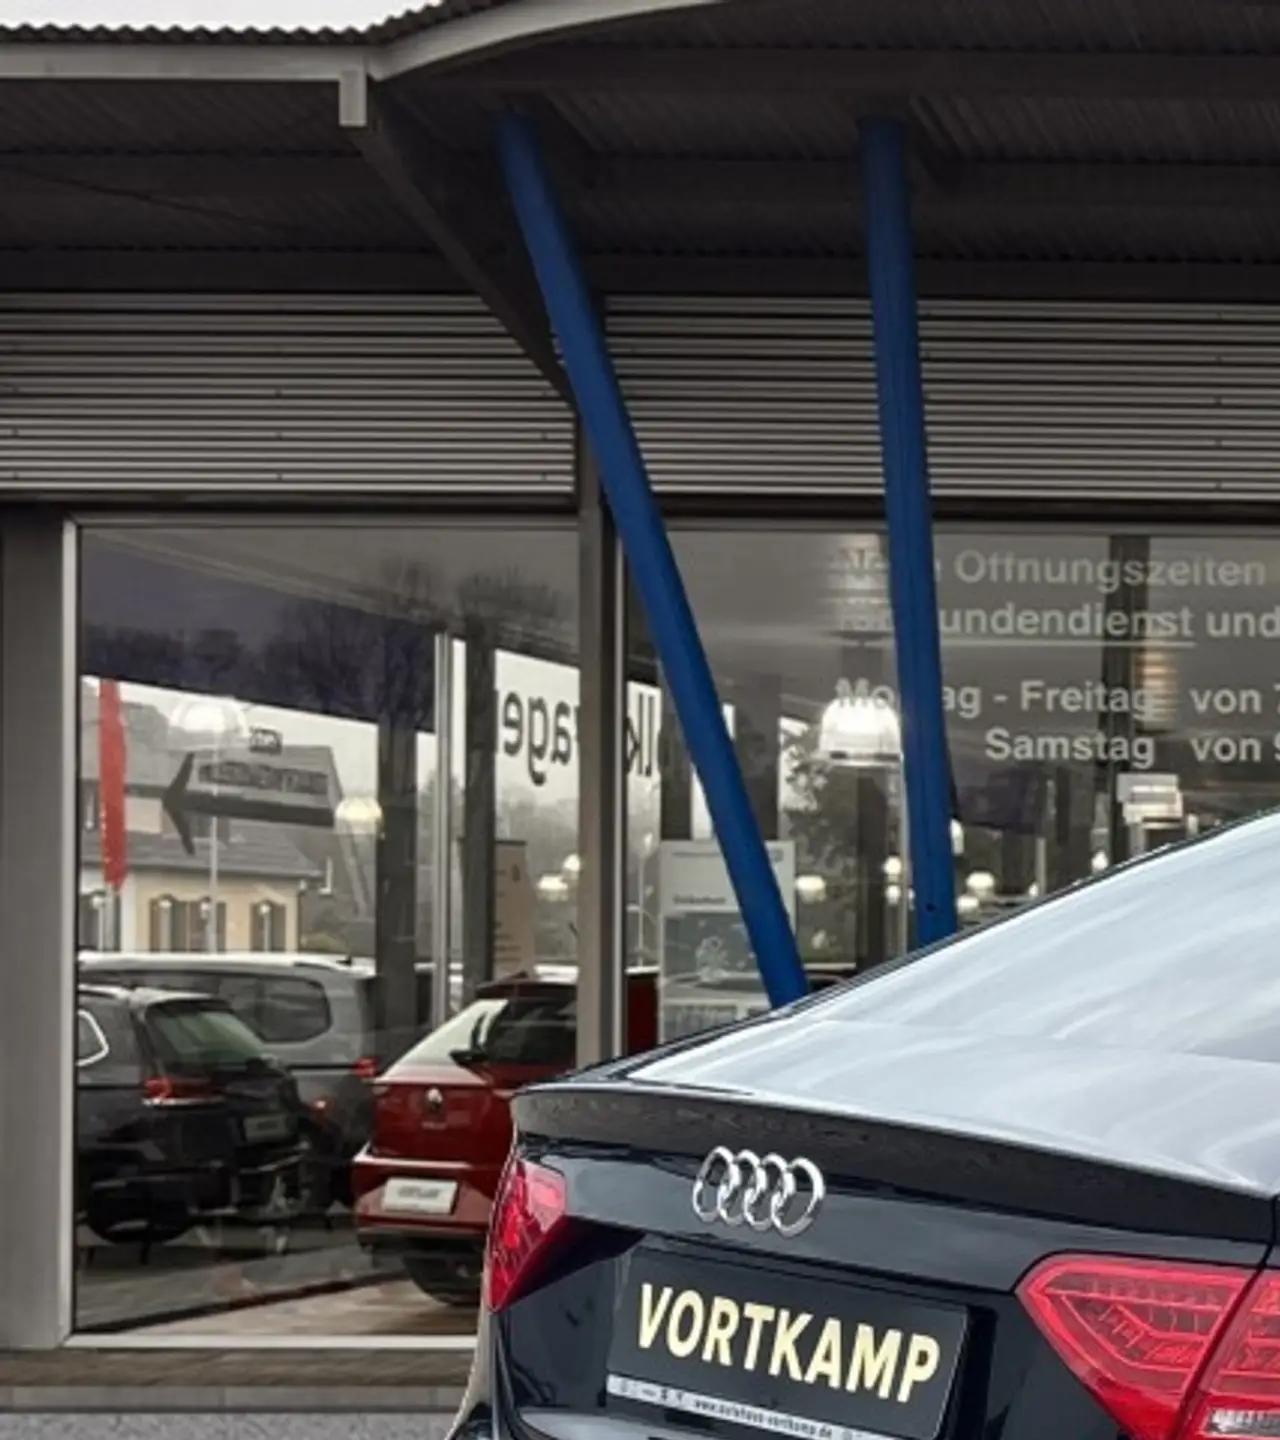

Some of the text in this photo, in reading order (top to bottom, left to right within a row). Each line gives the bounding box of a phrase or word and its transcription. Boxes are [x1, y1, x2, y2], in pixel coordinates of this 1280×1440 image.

[939, 601, 1193, 637] undendienst
[834, 678, 982, 719] Moag
[1020, 680, 1155, 722] Freitag
[1189, 687, 1263, 714] von
[985, 728, 1155, 770] Samstag
[1190, 737, 1263, 763] von
[637, 1282, 940, 1403] VORTKAMP
